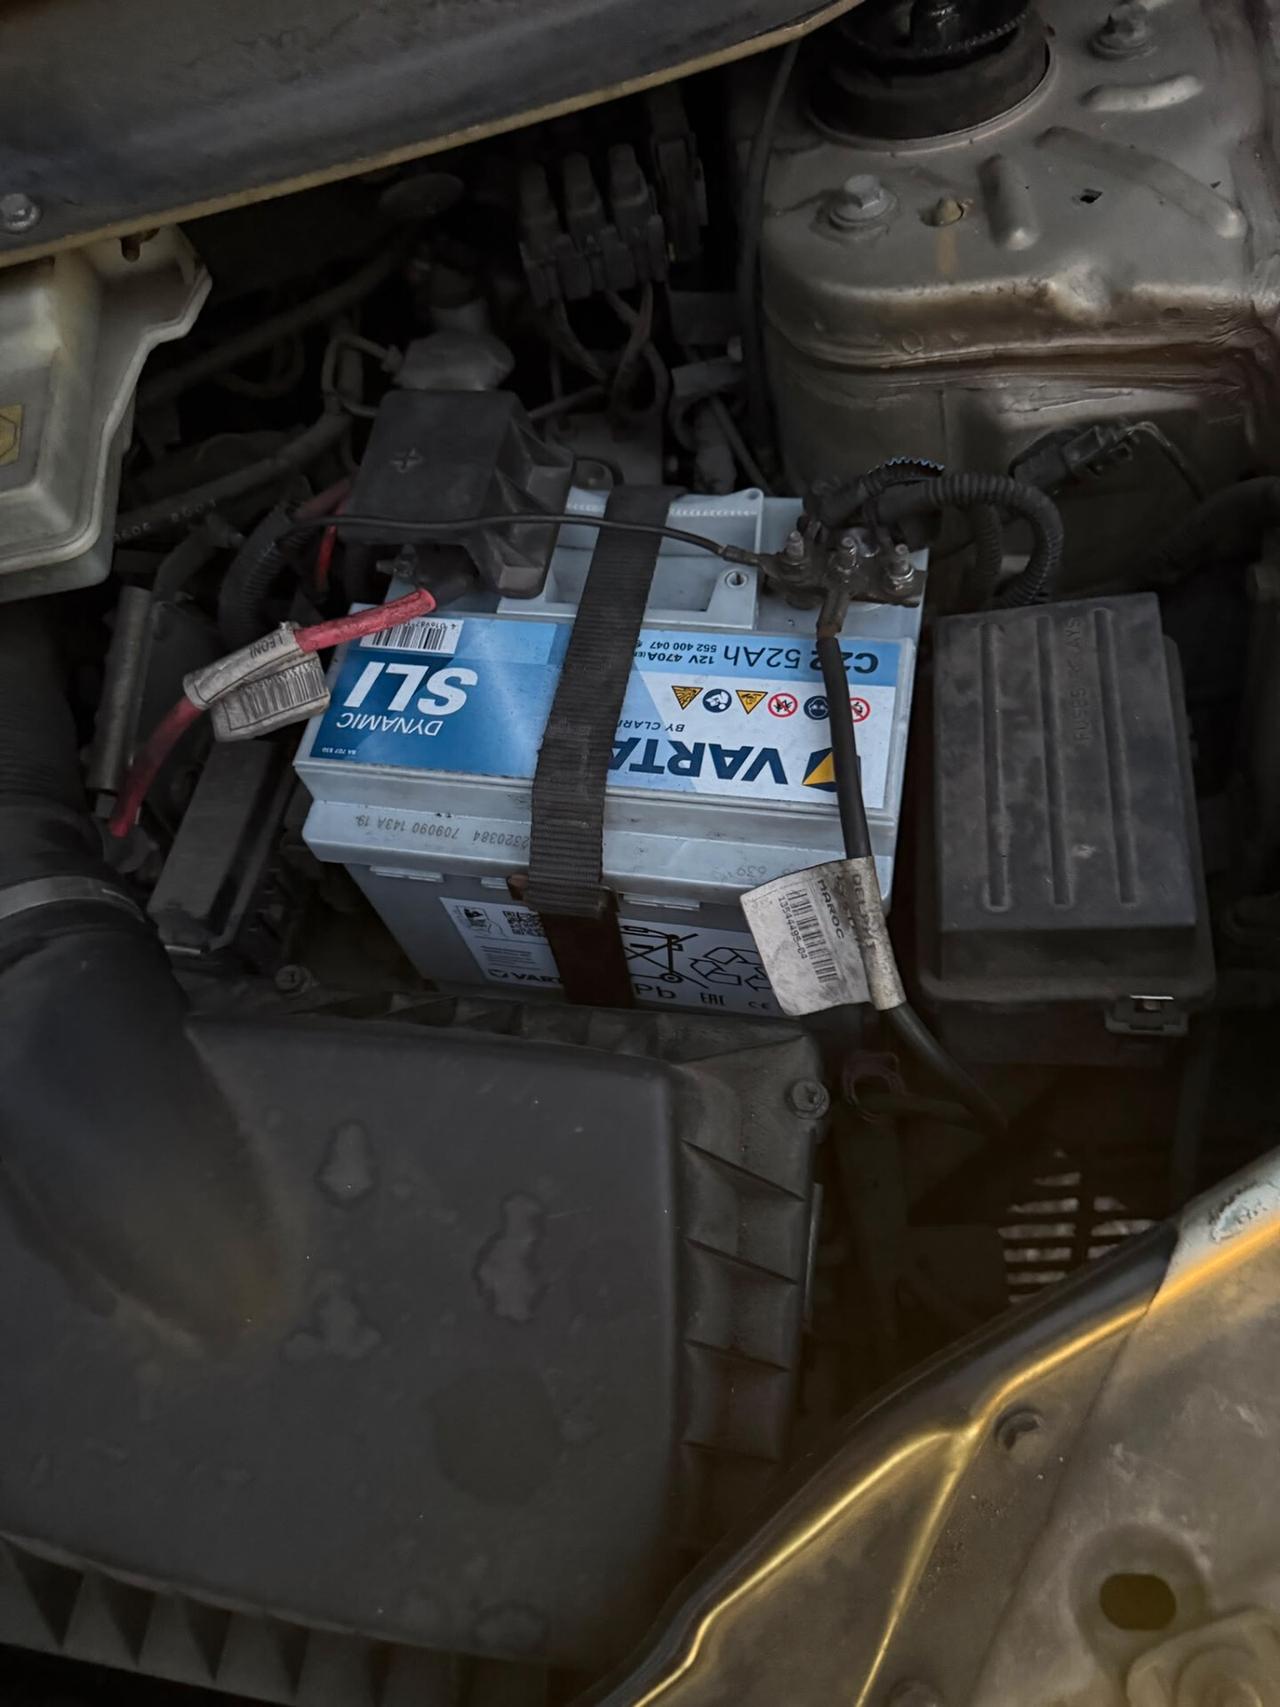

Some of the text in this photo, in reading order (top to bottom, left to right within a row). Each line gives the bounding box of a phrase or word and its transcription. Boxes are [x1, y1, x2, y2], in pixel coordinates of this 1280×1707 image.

[248, 633, 284, 659] LEONI
[649, 641, 670, 651] 047
[672, 642, 694, 652] 400
[696, 643, 717, 653] 552
[647, 652, 683, 663] 470A
[688, 654, 715, 665] 12V
[723, 644, 801, 669] 52Ah
[342, 660, 479, 716] SLI
[336, 712, 444, 737] DYNAMIC
[616, 719, 685, 733] BY CLARI
[608, 736, 788, 785] VARTA
[817, 879, 845, 940] MAROC
[633, 983, 677, 999] Pb
